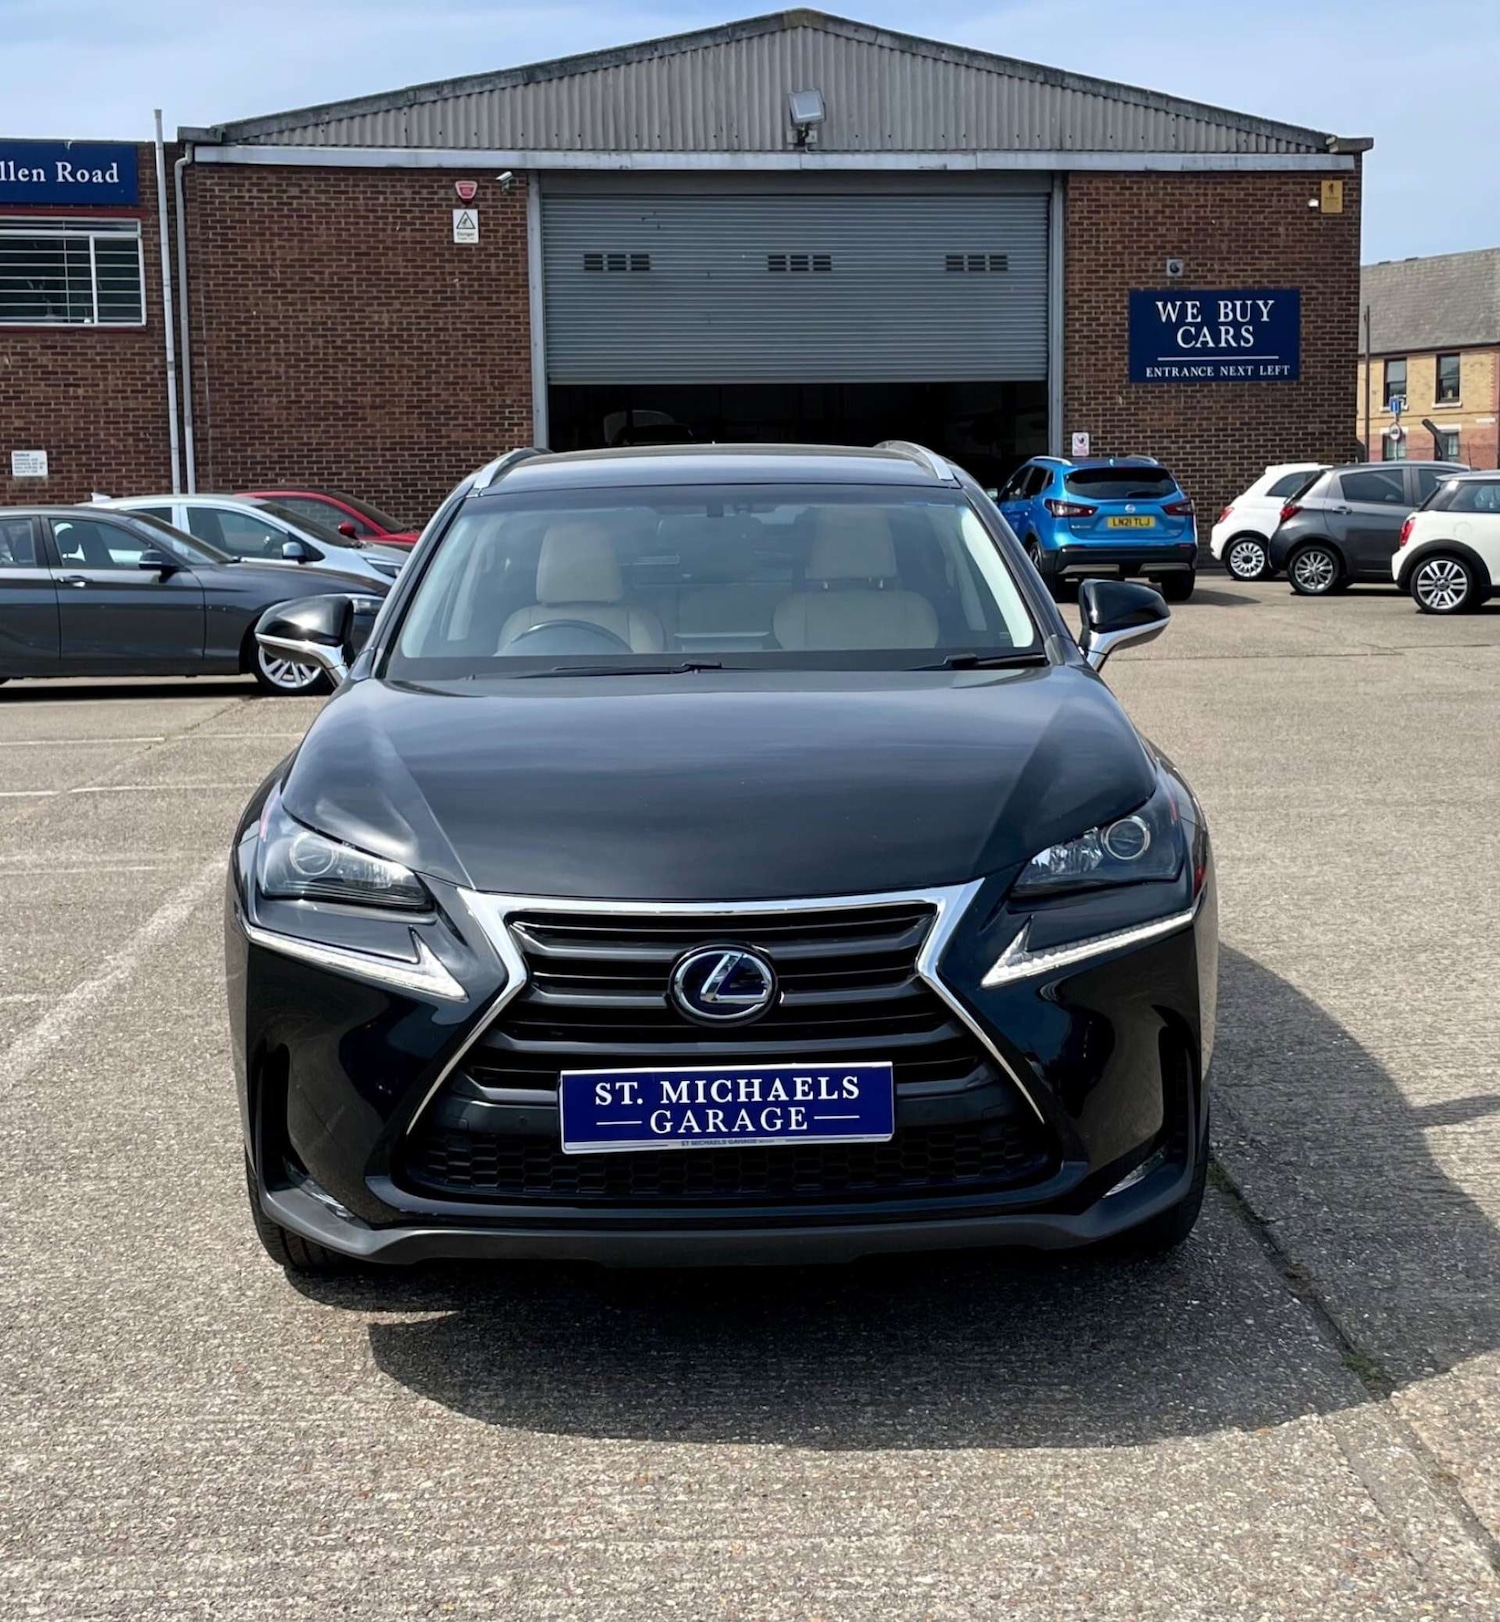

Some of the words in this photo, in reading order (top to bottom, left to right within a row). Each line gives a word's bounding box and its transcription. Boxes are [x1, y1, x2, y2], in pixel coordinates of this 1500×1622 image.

[55, 161, 120, 183] Road
[1155, 300, 1202, 323] WE
[1217, 299, 1275, 323] BUY
[1176, 325, 1255, 349] CARS
[1146, 366, 1215, 378] ENTRANCE
[1219, 365, 1254, 376] NEXT
[1259, 364, 1290, 376] LEFT
[595, 1081, 644, 1106] ST.
[660, 1075, 860, 1104] MICHAELS
[650, 1106, 808, 1134] GARAGE
